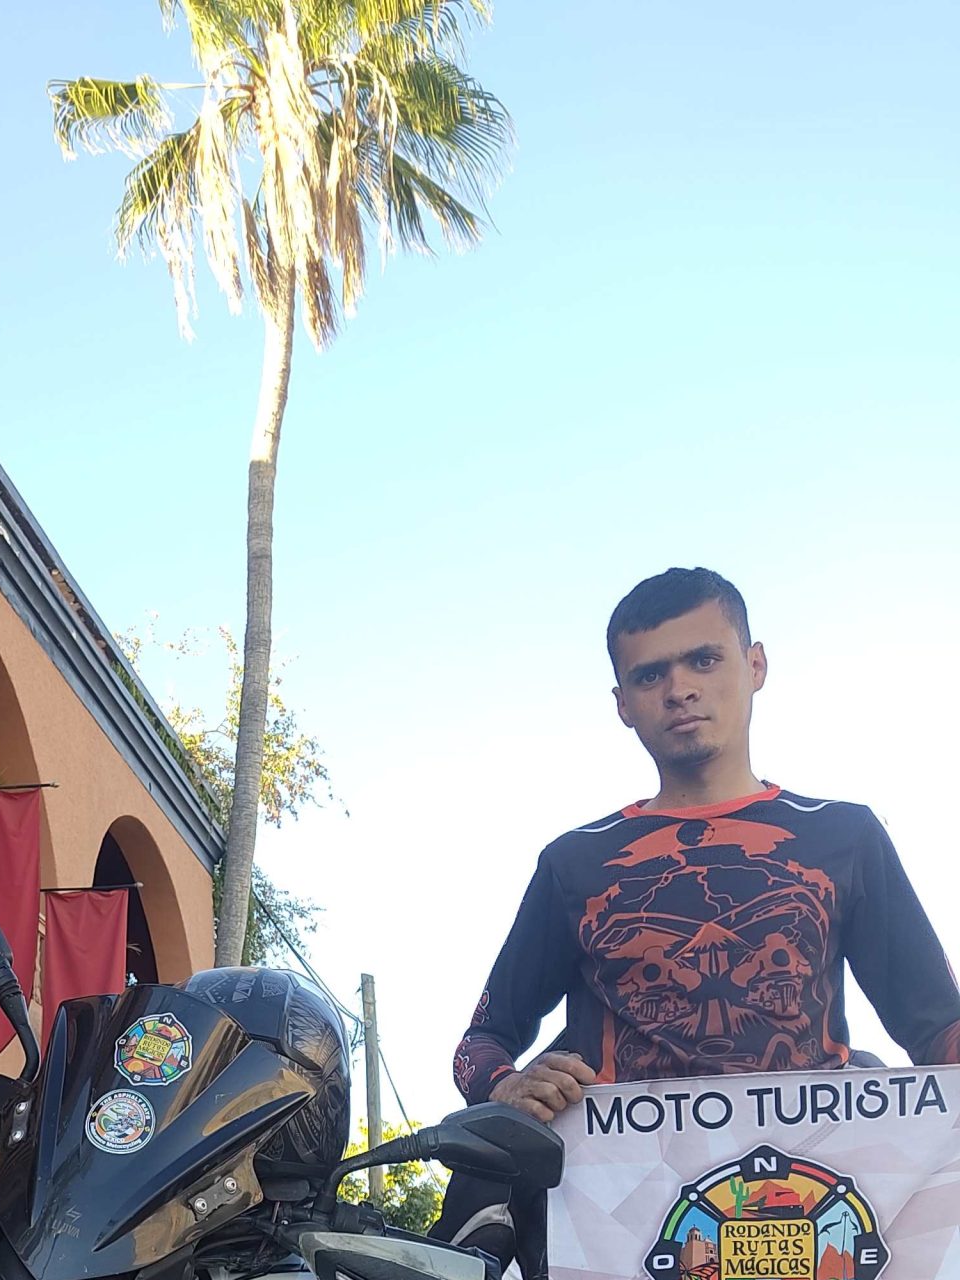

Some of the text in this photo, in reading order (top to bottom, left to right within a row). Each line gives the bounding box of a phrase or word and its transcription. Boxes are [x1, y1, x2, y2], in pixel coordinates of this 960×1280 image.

[586, 1075, 947, 1135] MOTO TURISTA
[753, 1156, 778, 1173] N
[652, 1254, 675, 1270] O
[859, 1248, 879, 1265] E
